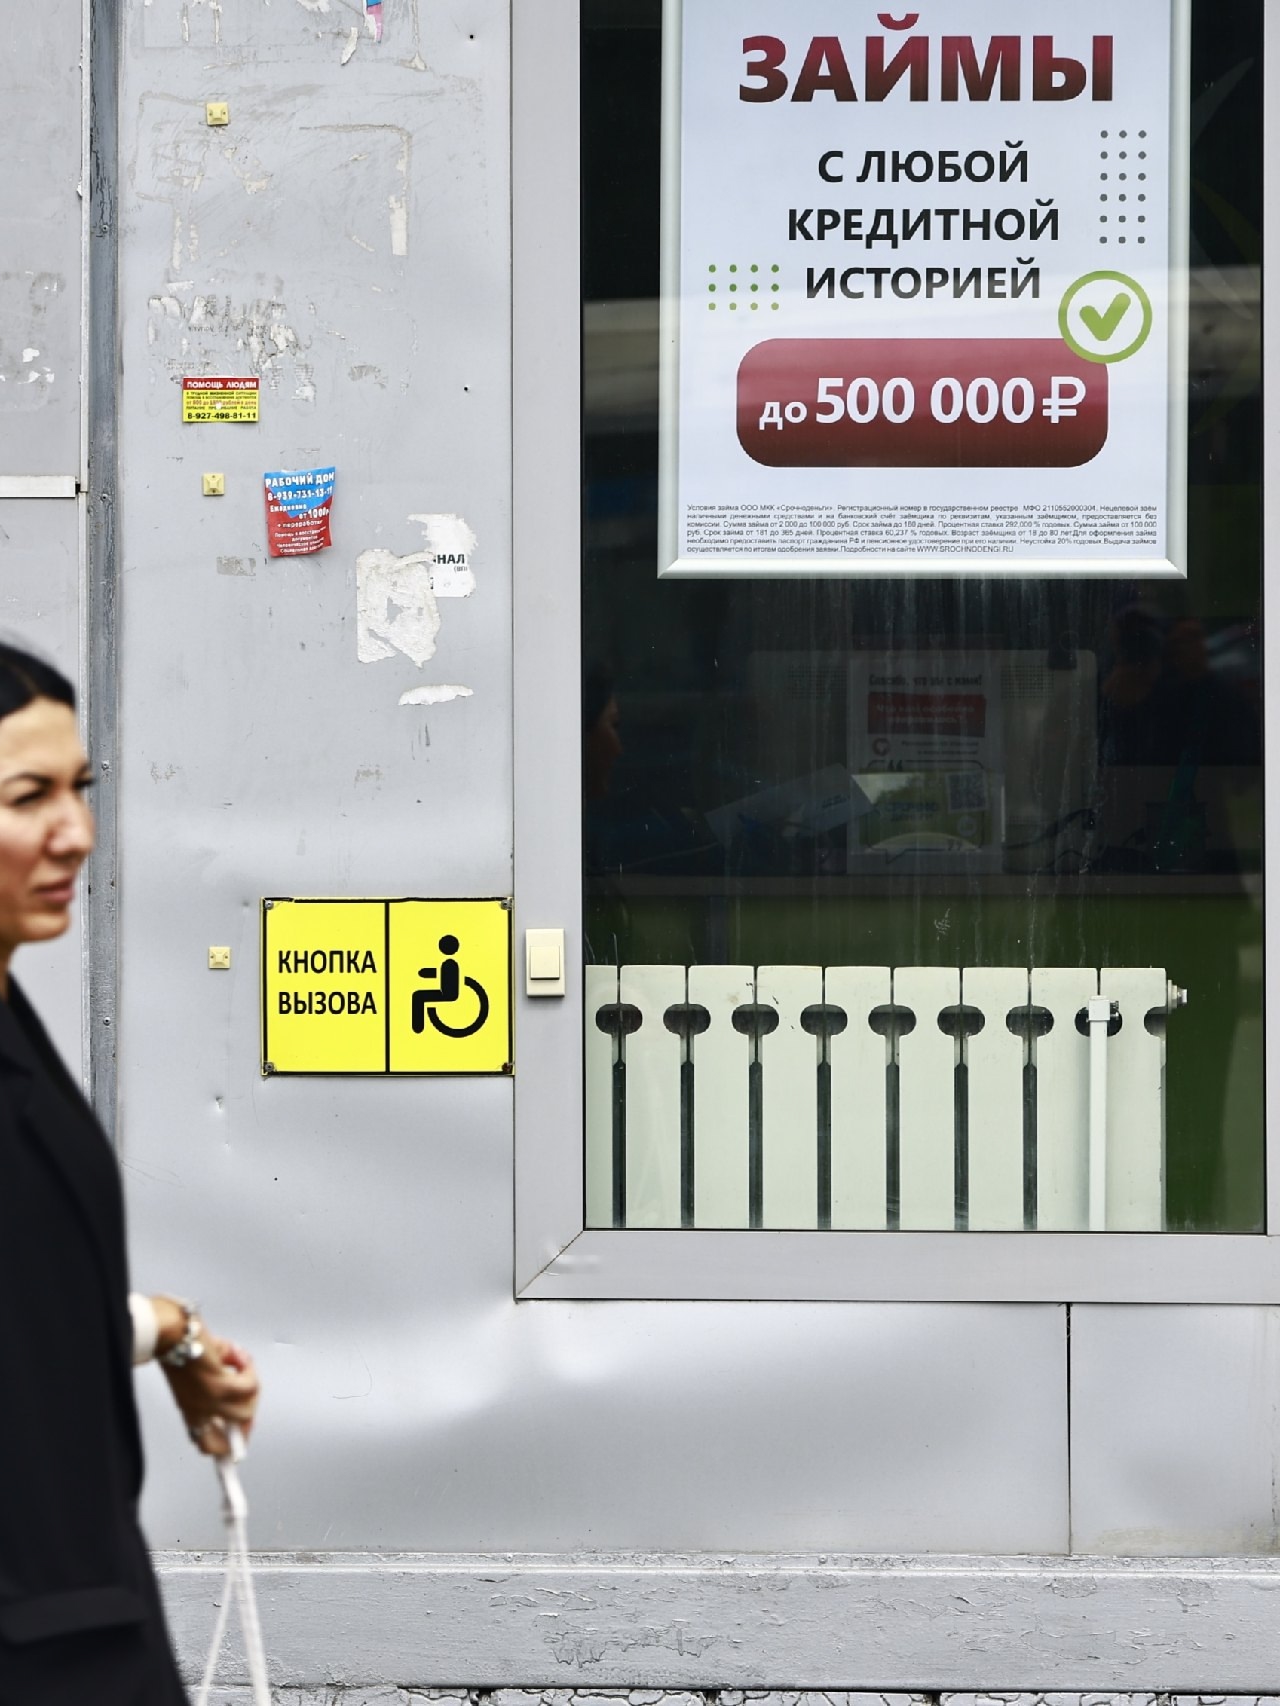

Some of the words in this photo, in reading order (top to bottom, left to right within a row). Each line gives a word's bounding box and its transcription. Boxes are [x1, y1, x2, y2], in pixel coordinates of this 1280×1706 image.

[739, 13, 1114, 103] ЗАЙМЫ
[818, 150, 843, 183] С
[857, 140, 1029, 183] ЛЮБОЙ
[788, 198, 1059, 249] КРЕДИТНОЙ
[806, 257, 1041, 299] ИСТОРИЕЙ
[187, 381, 223, 389] ПОМОЩЬ
[226, 381, 257, 389] ЛЮДЯМ
[759, 401, 807, 430] до
[816, 377, 915, 424] 500
[265, 473, 313, 488] РАБОЧИЙ
[316, 472, 335, 485] ДОМ
[433, 554, 465, 564] НАЛ
[278, 950, 377, 974] КНОПКА
[278, 991, 377, 1015] ВЫЗОВА
